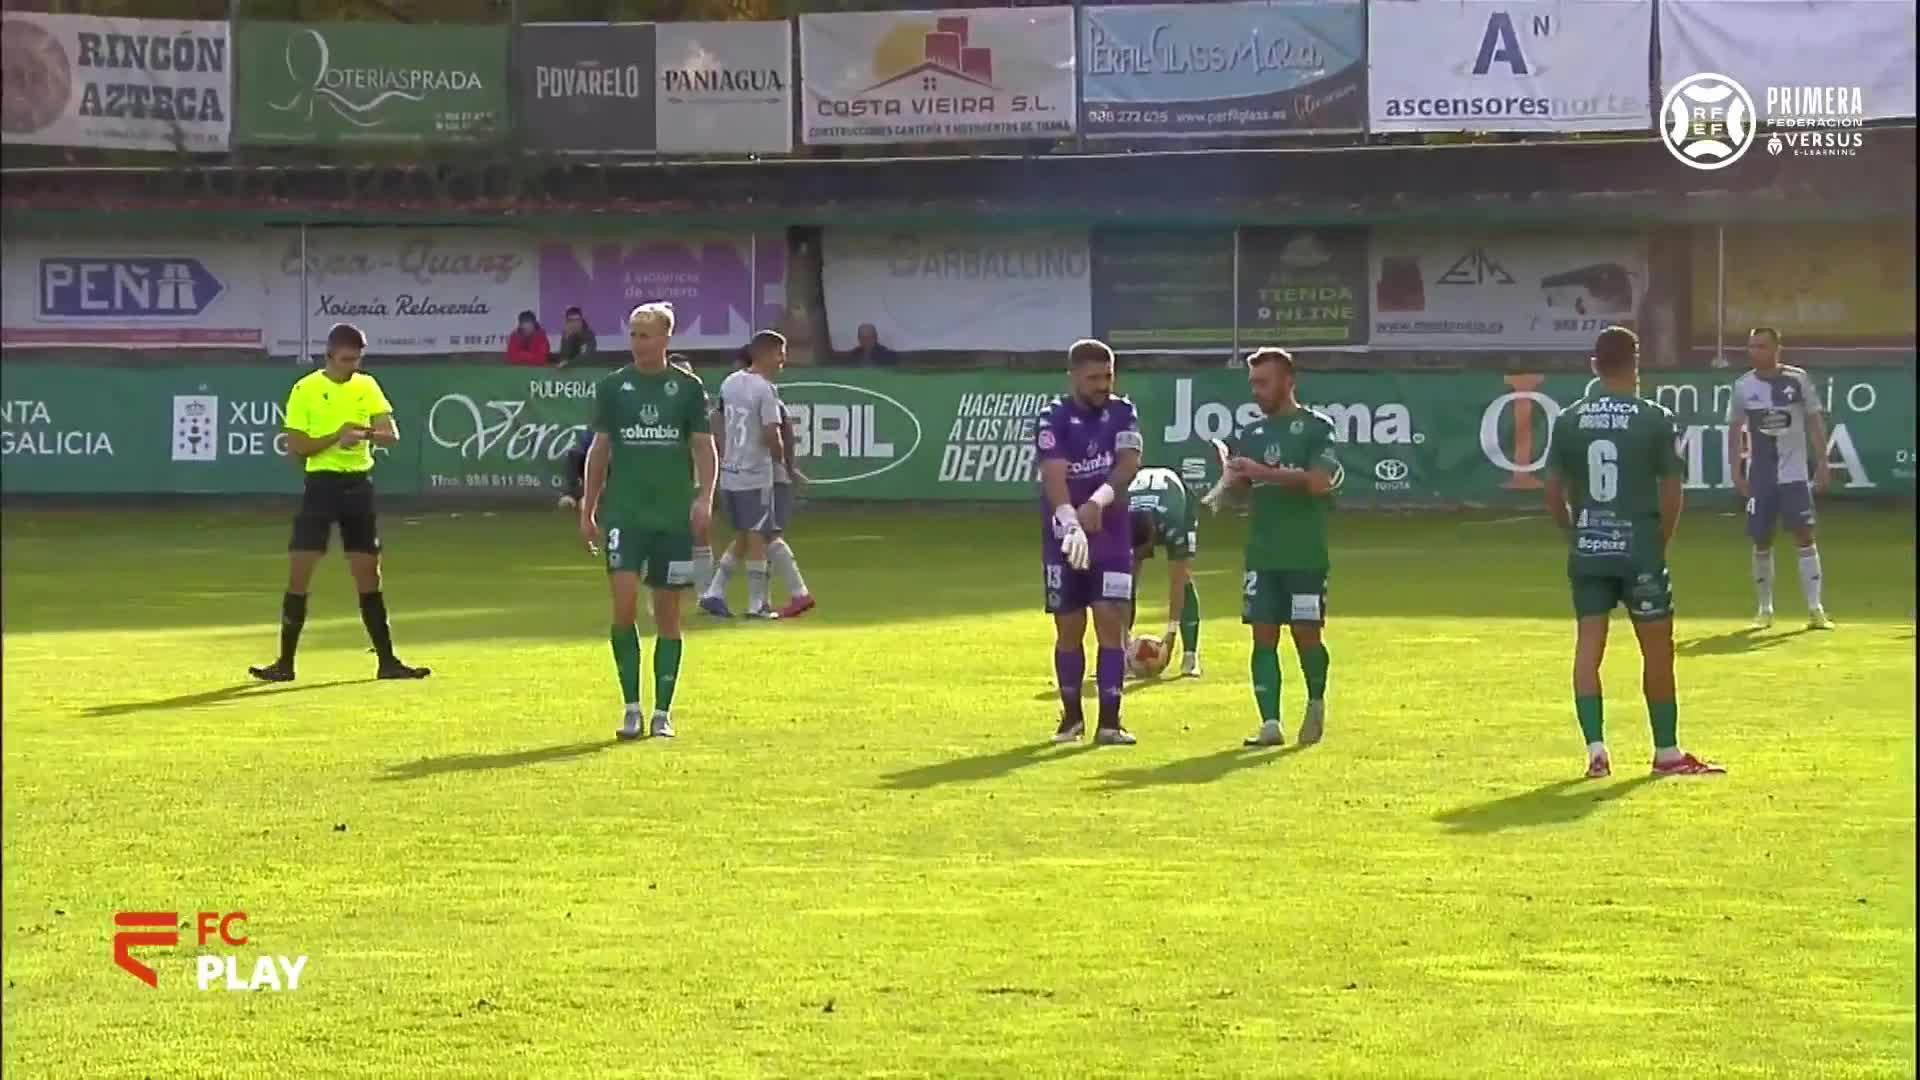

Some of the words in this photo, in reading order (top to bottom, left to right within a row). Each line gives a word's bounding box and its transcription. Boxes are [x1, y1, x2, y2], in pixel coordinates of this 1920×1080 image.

[78, 30, 225, 72] RINCÓN
[1472, 12, 1528, 75] A
[664, 69, 784, 92] PANIAGUA
[79, 82, 224, 122] AZTECA
[817, 98, 900, 116] COSTA
[911, 97, 994, 114] VIEIRA
[1011, 95, 1056, 112] S.L.
[1258, 288, 1353, 302] TIENDA
[948, 418, 962, 442] A
[965, 418, 1001, 442] LOS
[228, 433, 264, 455] DE
[938, 443, 1042, 482] DEPOR
[1587, 439, 1618, 502] 6
[608, 528, 620, 549] 3
[1046, 565, 1062, 588] 13
